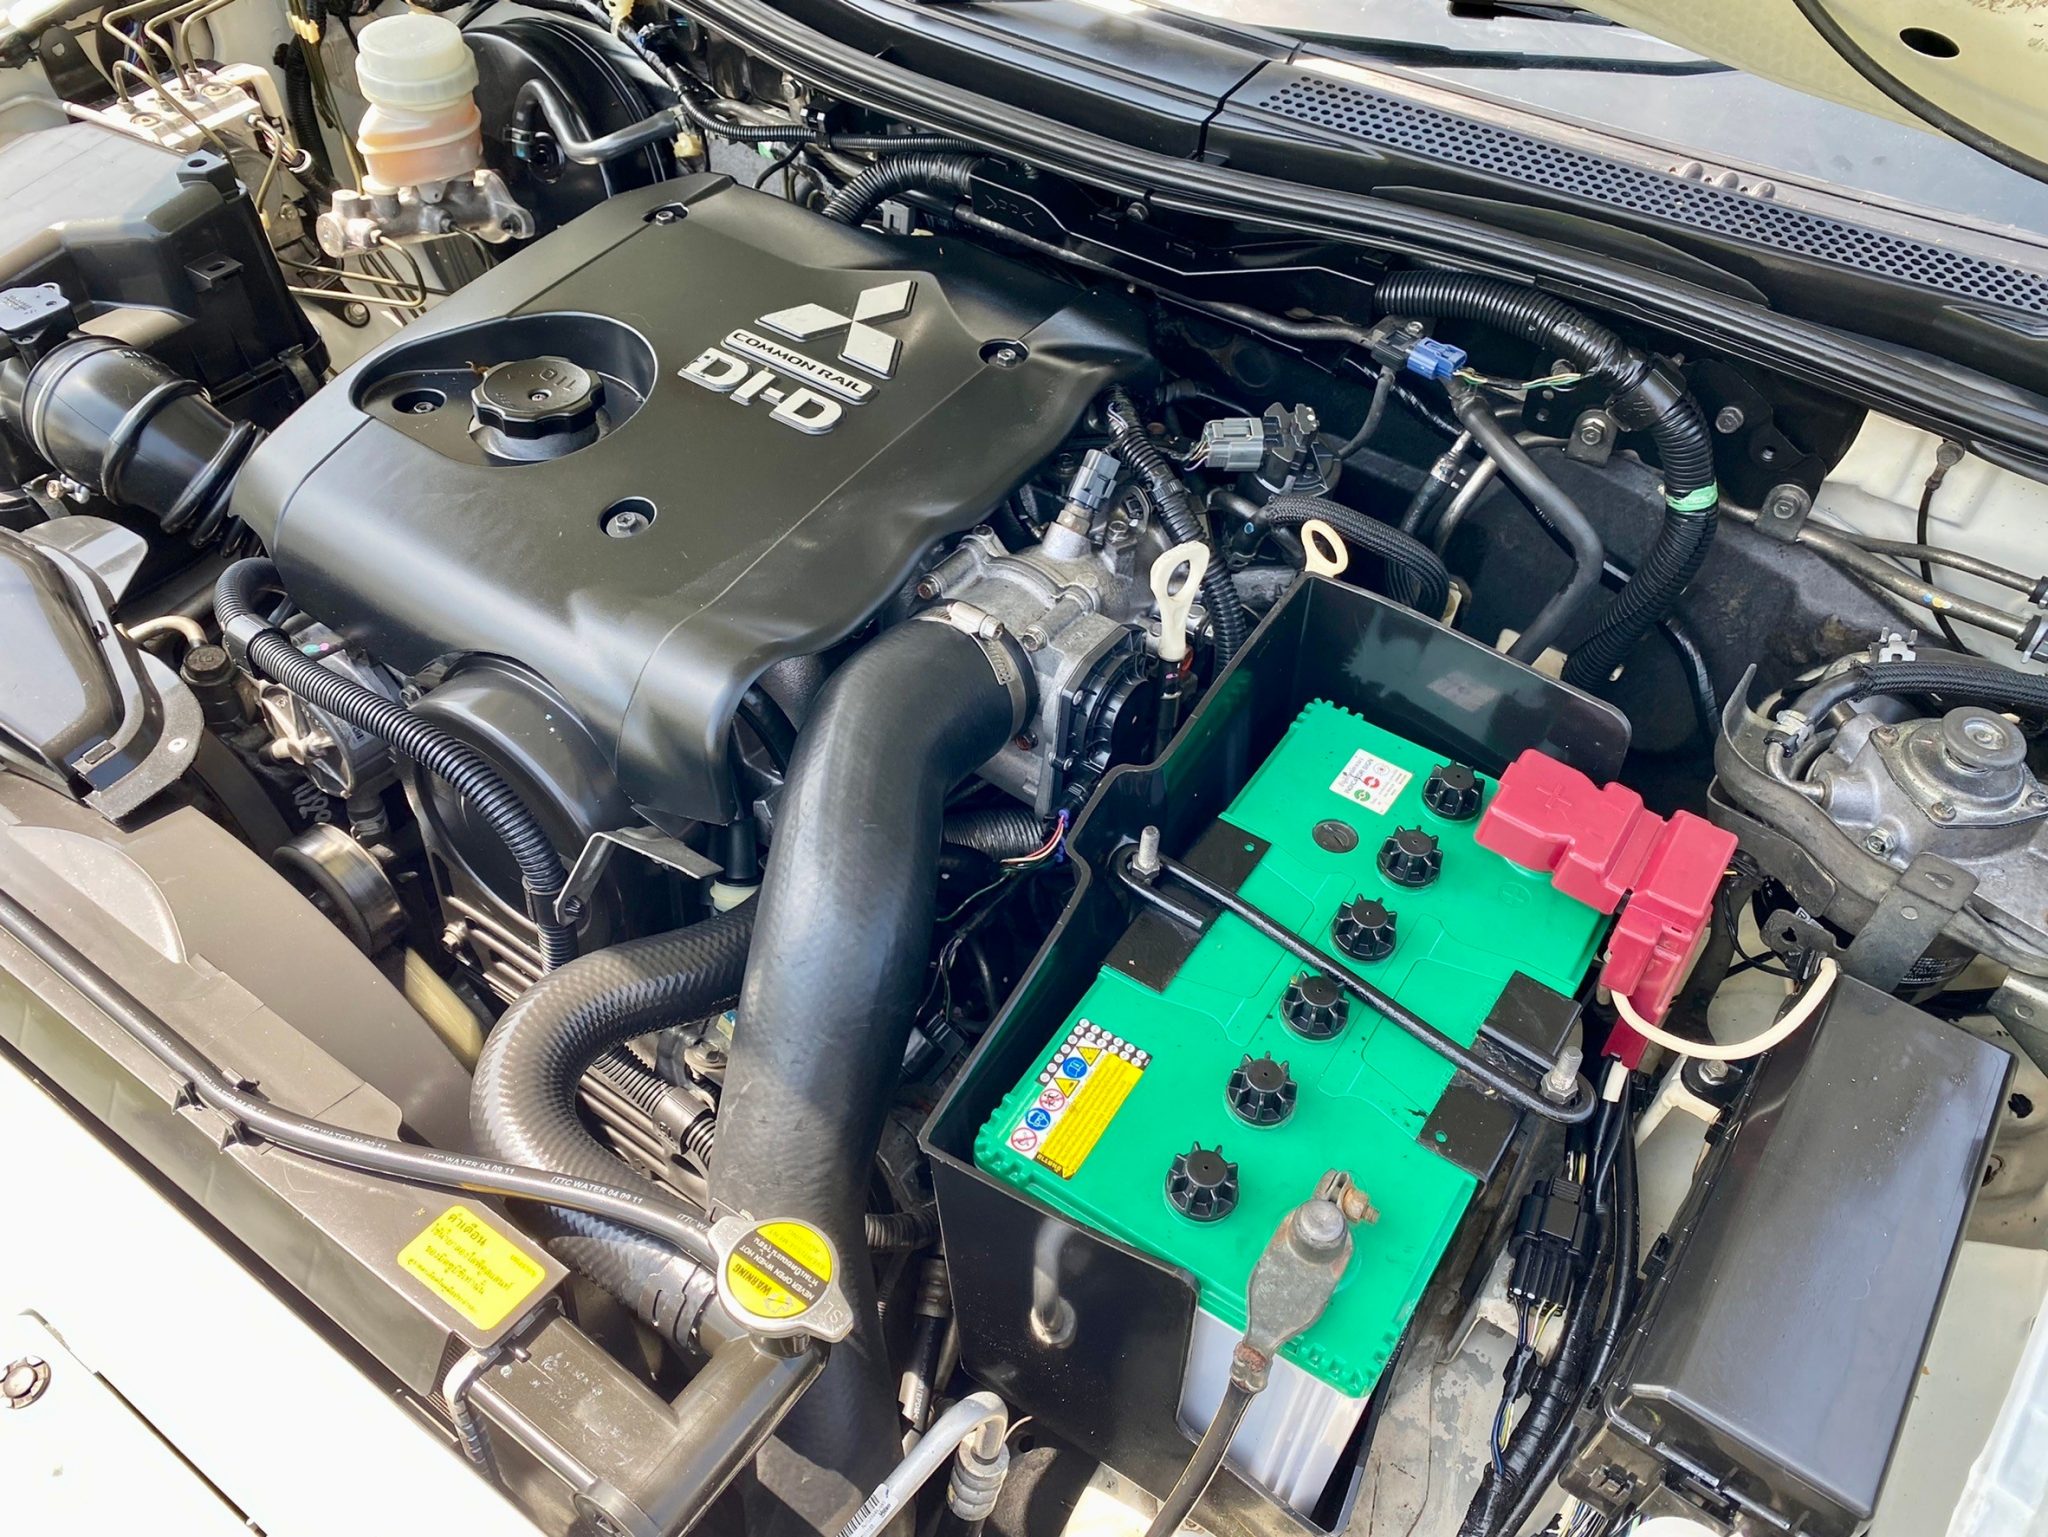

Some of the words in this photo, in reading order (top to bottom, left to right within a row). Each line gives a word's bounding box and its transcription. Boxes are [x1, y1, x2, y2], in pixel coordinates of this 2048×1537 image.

[732, 332, 816, 371] COMMON
[816, 366, 863, 394] RAIL
[677, 347, 847, 435] DI-D
[573, 1181, 608, 1195] WATER
[607, 1189, 620, 1198] 04
[619, 1193, 632, 1201] 09
[632, 1196, 644, 1205] 11
[739, 1244, 755, 1258] HOT
[753, 1254, 775, 1272] WHEN
[732, 1263, 772, 1296] WARNING
[773, 1268, 793, 1285] OPEN
[790, 1281, 815, 1301] NEVER
